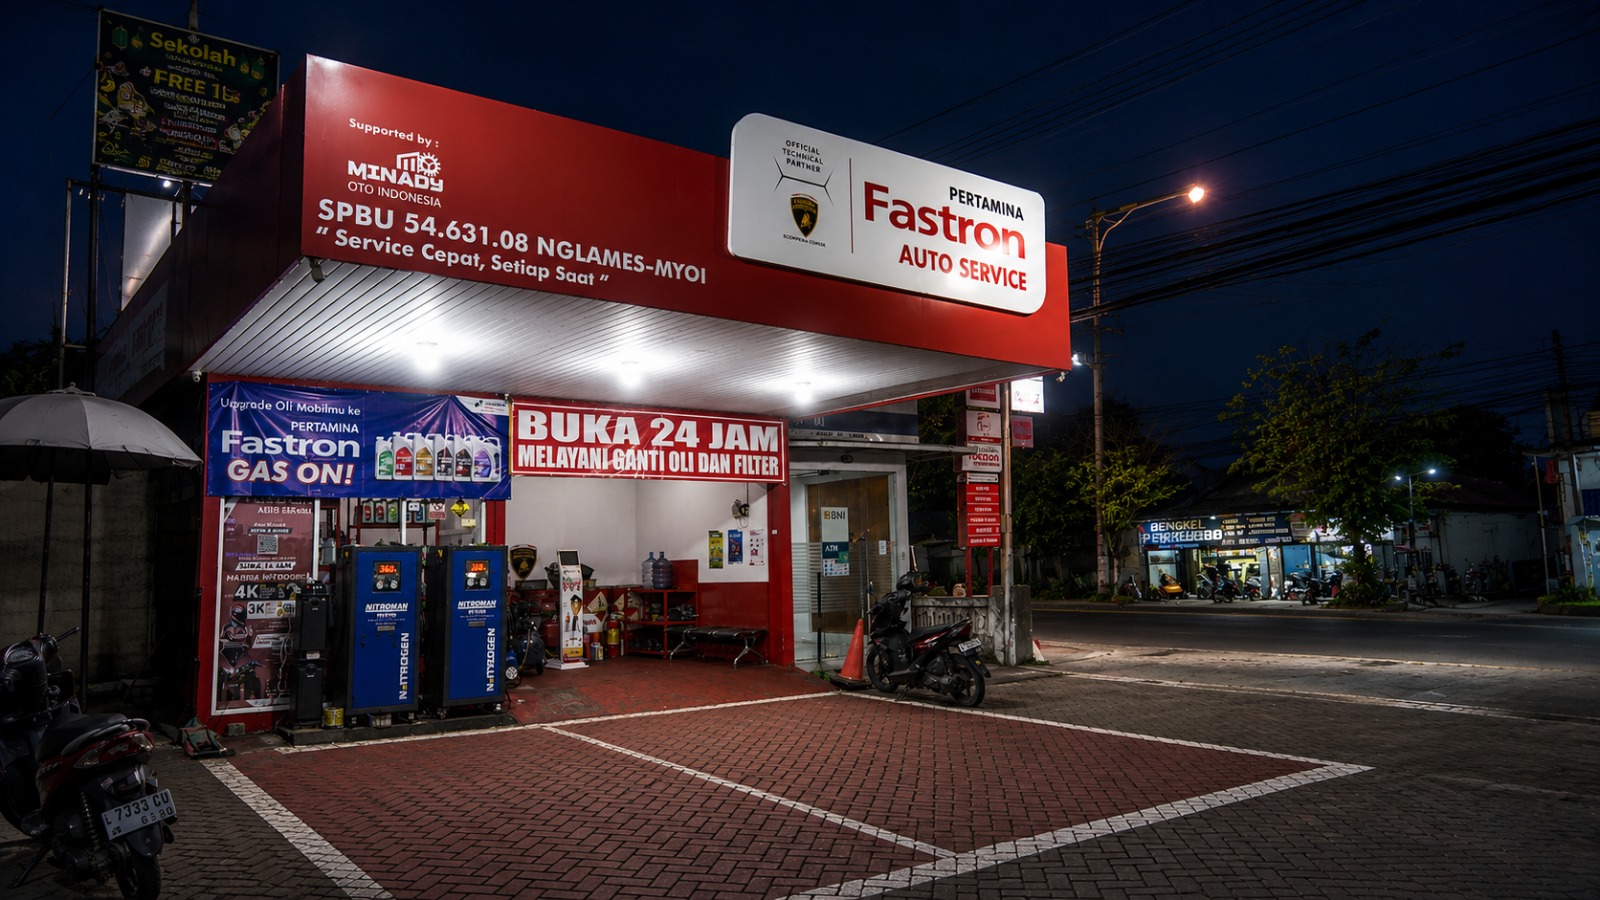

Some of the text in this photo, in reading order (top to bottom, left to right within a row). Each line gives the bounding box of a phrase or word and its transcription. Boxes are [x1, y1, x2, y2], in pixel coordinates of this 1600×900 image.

[150, 32, 236, 67] Sekolah
[153, 69, 206, 95] FREE
[349, 118, 414, 142] Supported
[417, 134, 432, 148] by
[782, 147, 824, 165] TECHNICAL
[785, 140, 820, 156] OFFICIAL
[348, 160, 444, 193] MINADY
[786, 158, 821, 173] PARTNER
[348, 181, 442, 208] OTO INDONESIA
[949, 186, 1024, 221] PERTAMINA
[318, 198, 394, 230] SPBU
[404, 212, 529, 252] 54.631.08
[864, 181, 1026, 260] Fastron
[334, 229, 415, 257] Service
[421, 243, 485, 272] Cepat,
[491, 254, 550, 282] Setiap
[556, 266, 595, 286] Saat
[898, 244, 1027, 292] AUTO SERVICE
[297, 403, 345, 415] Mobilmu
[348, 405, 361, 416] ke
[290, 421, 359, 433] PERTAMINA
[517, 409, 779, 453] BUKA 24 JAM
[221, 430, 360, 458] Fastron
[227, 459, 288, 483] GAS
[296, 462, 355, 485] ON!
[517, 444, 609, 471] MELAYANI
[613, 449, 665, 473] GANTI
[668, 450, 694, 473] OLI
[698, 452, 730, 475] DAN
[734, 454, 779, 476] FILTER
[234, 583, 260, 600] 4K
[457, 599, 497, 609] NITROMAN
[248, 602, 265, 616] 3K
[365, 602, 409, 612] NITROMAN
[114, 799, 150, 822] 7333
[152, 791, 170, 808] CU
